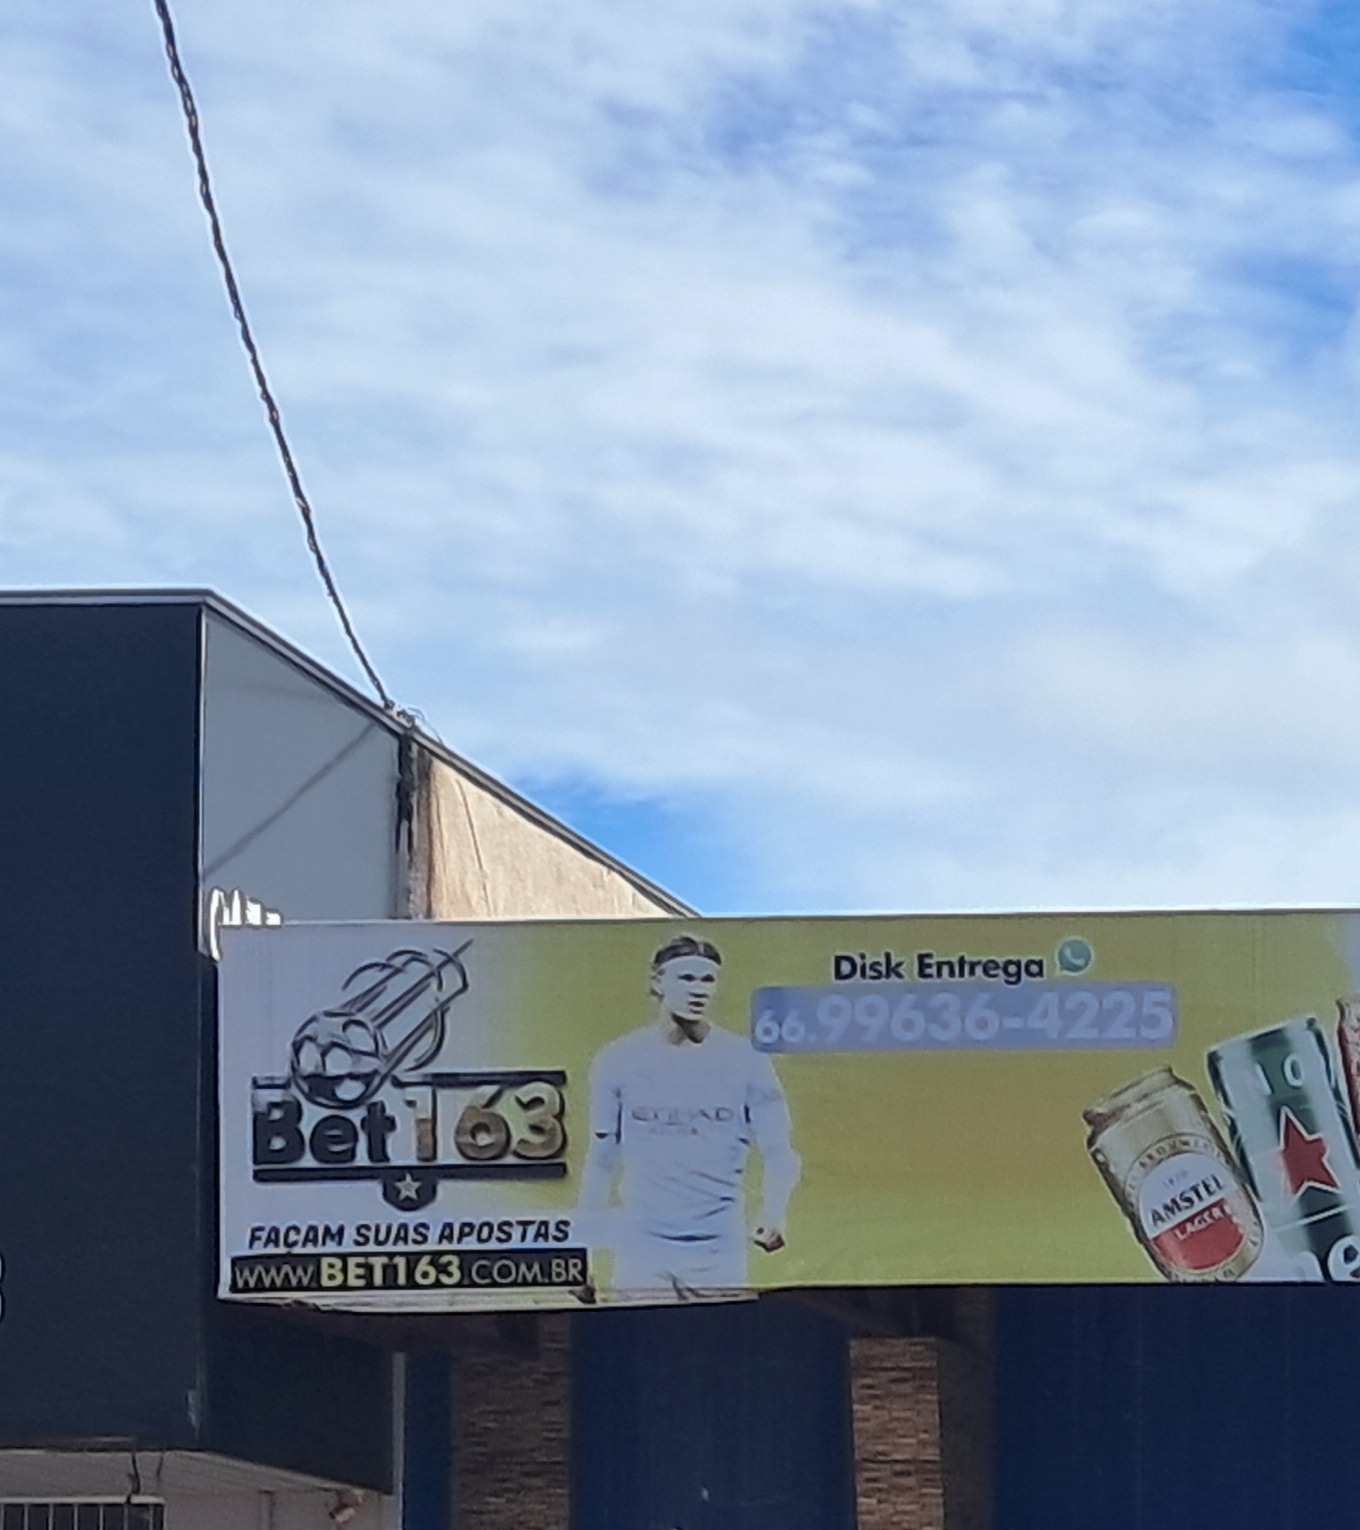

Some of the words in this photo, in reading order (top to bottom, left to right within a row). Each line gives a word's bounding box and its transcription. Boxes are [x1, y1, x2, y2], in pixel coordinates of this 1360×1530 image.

[833, 953, 904, 981] Disk
[916, 954, 1046, 985] Entrega
[753, 990, 1175, 1045] 66.99636-4225
[352, 1222, 431, 1247] SUAS
[437, 1219, 571, 1245] APOSTAS
